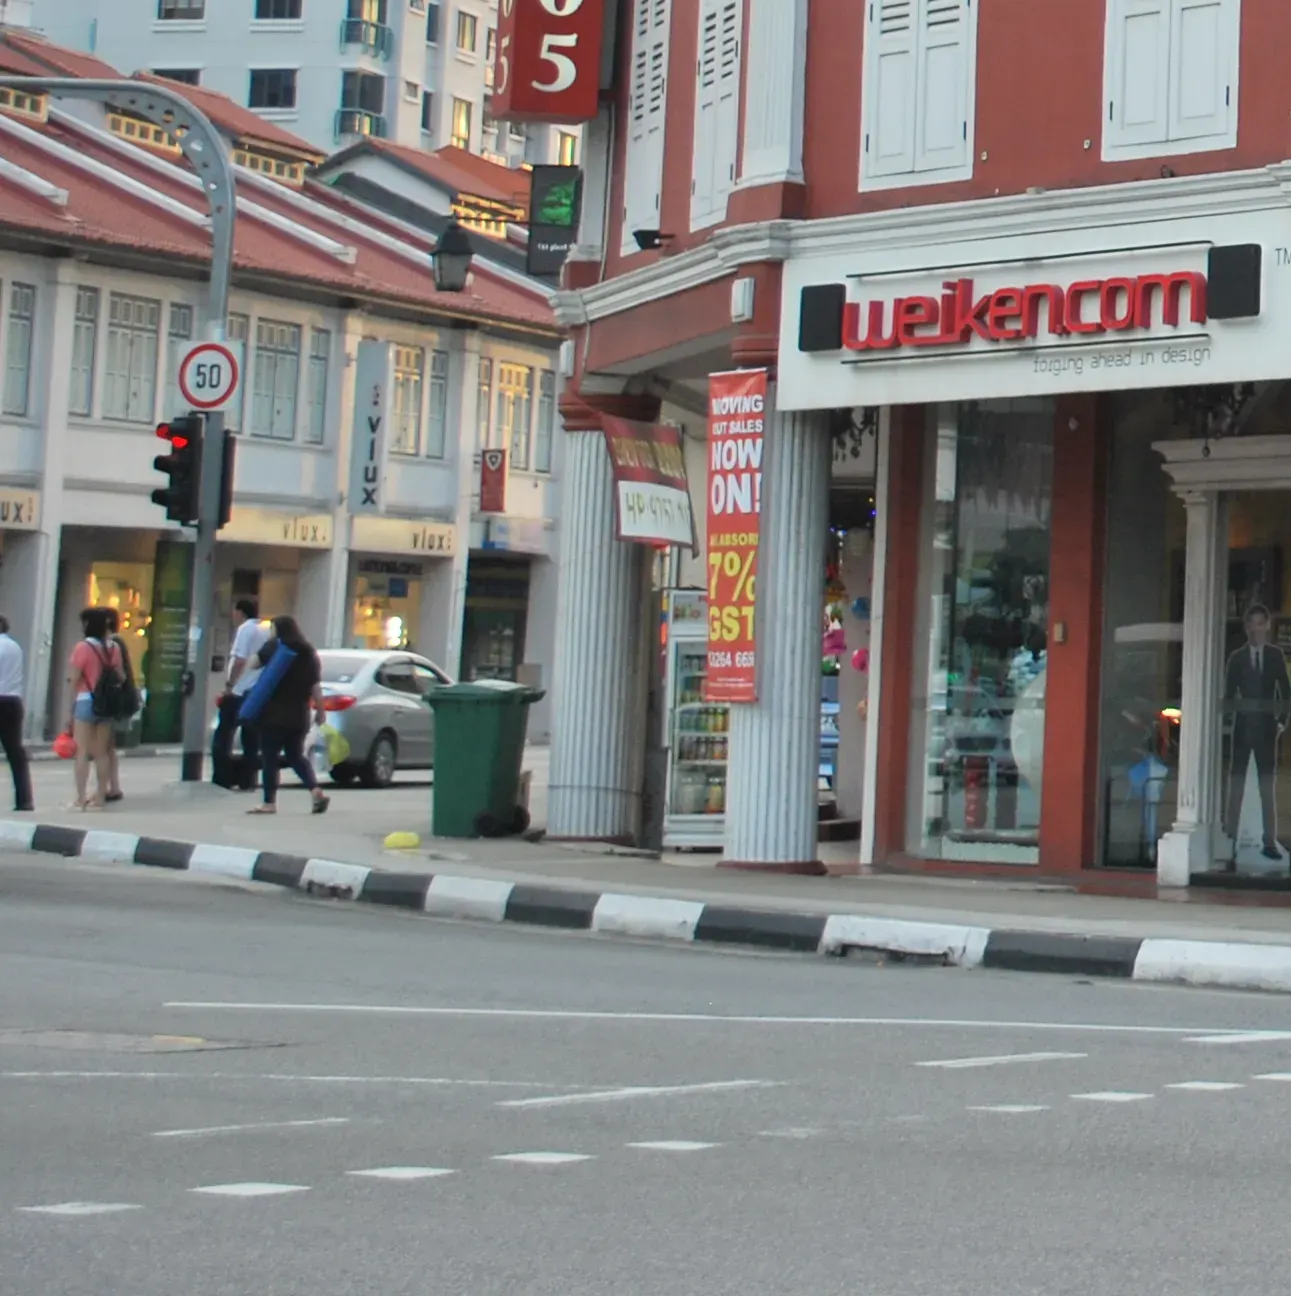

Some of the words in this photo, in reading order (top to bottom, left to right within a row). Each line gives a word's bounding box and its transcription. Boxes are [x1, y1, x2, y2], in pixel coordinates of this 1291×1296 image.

[842, 270, 1208, 351] weiken.com
[196, 363, 222, 389] 50
[1033, 354, 1084, 376] forging
[1090, 348, 1132, 369] ahead
[1140, 350, 1155, 366] in
[1161, 346, 1211, 366] design
[711, 393, 764, 416] MOVING
[729, 418, 764, 435] SALES
[711, 437, 764, 471] NOW
[711, 471, 762, 516] ON!
[708, 605, 756, 642] GST
